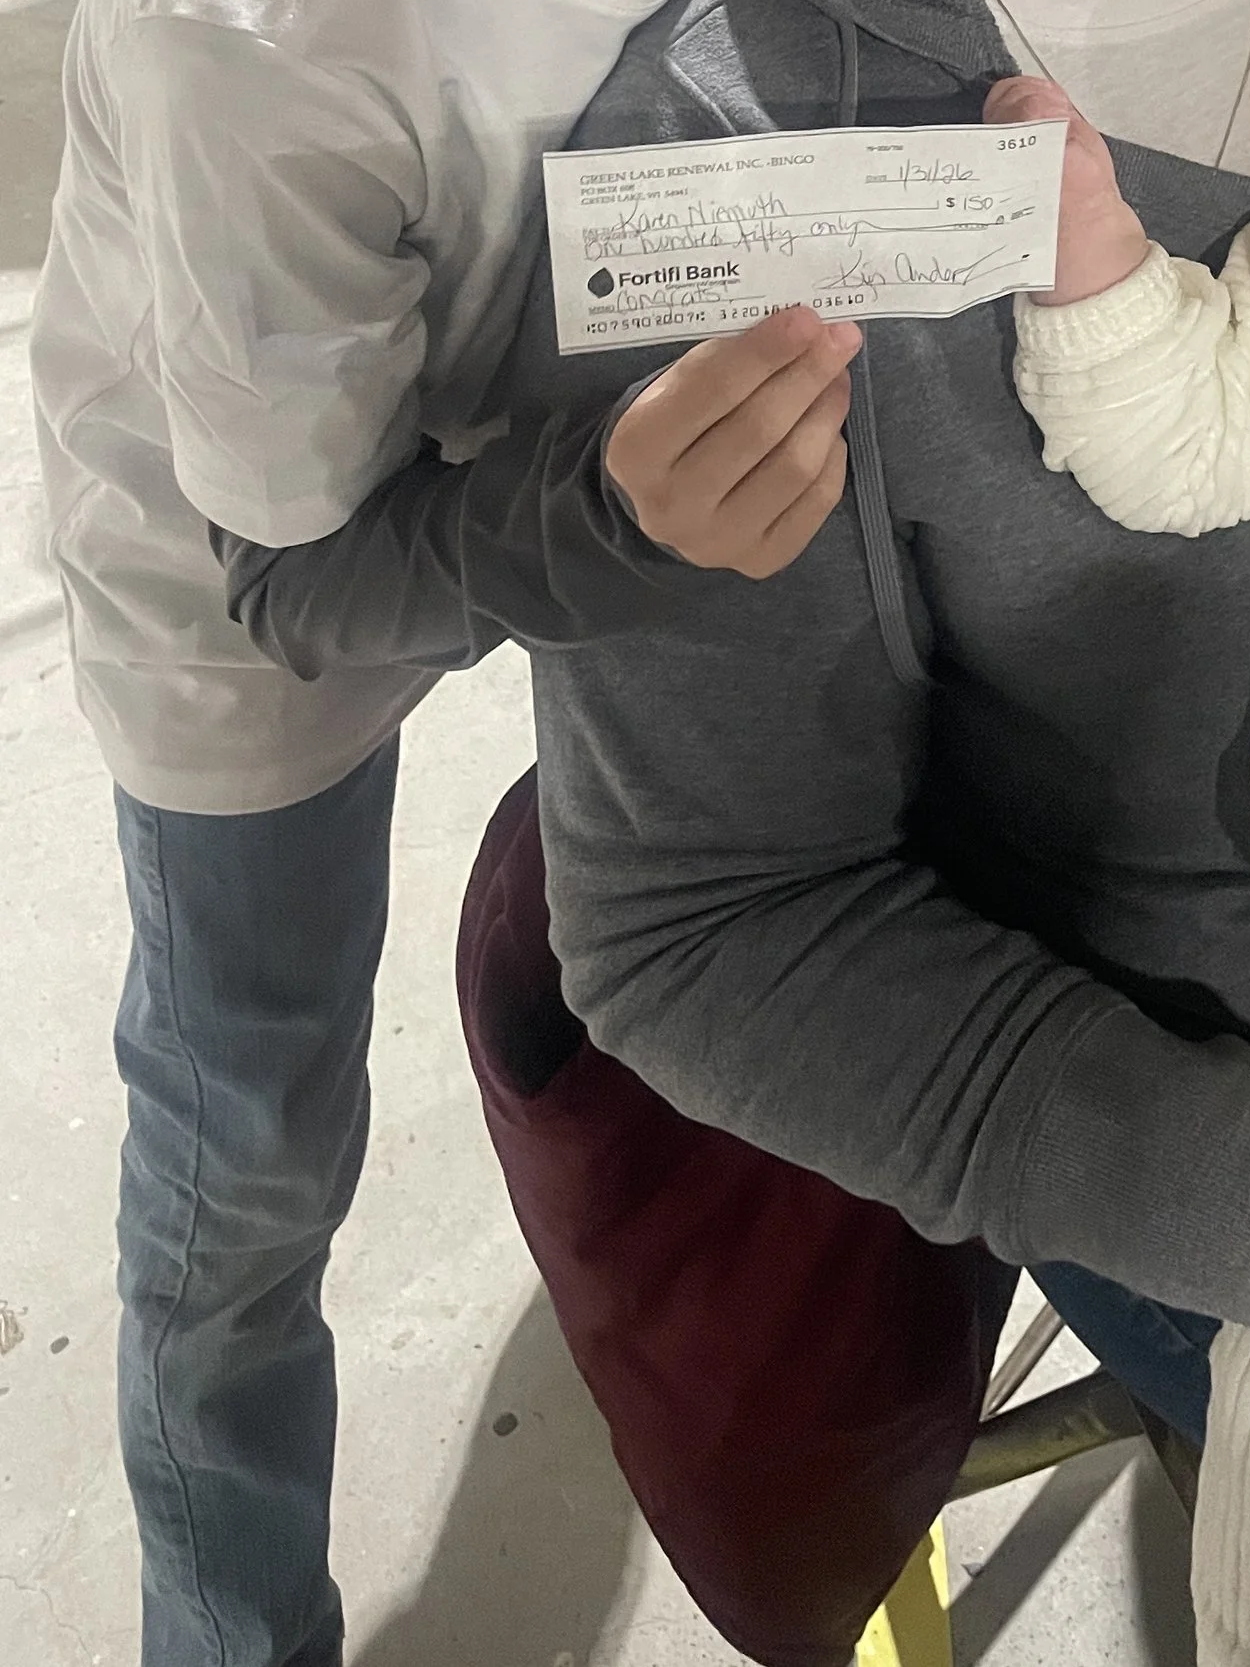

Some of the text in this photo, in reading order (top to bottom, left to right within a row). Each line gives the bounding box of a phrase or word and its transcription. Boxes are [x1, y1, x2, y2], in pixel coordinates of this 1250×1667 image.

[997, 135, 1037, 151] 3610
[580, 172, 626, 185] GREEN
[629, 168, 666, 181] LAKE
[667, 162, 734, 177] RENEWAL
[963, 195, 994, 211] 150
[619, 266, 681, 287] Fortifi
[686, 261, 740, 281] Bank
